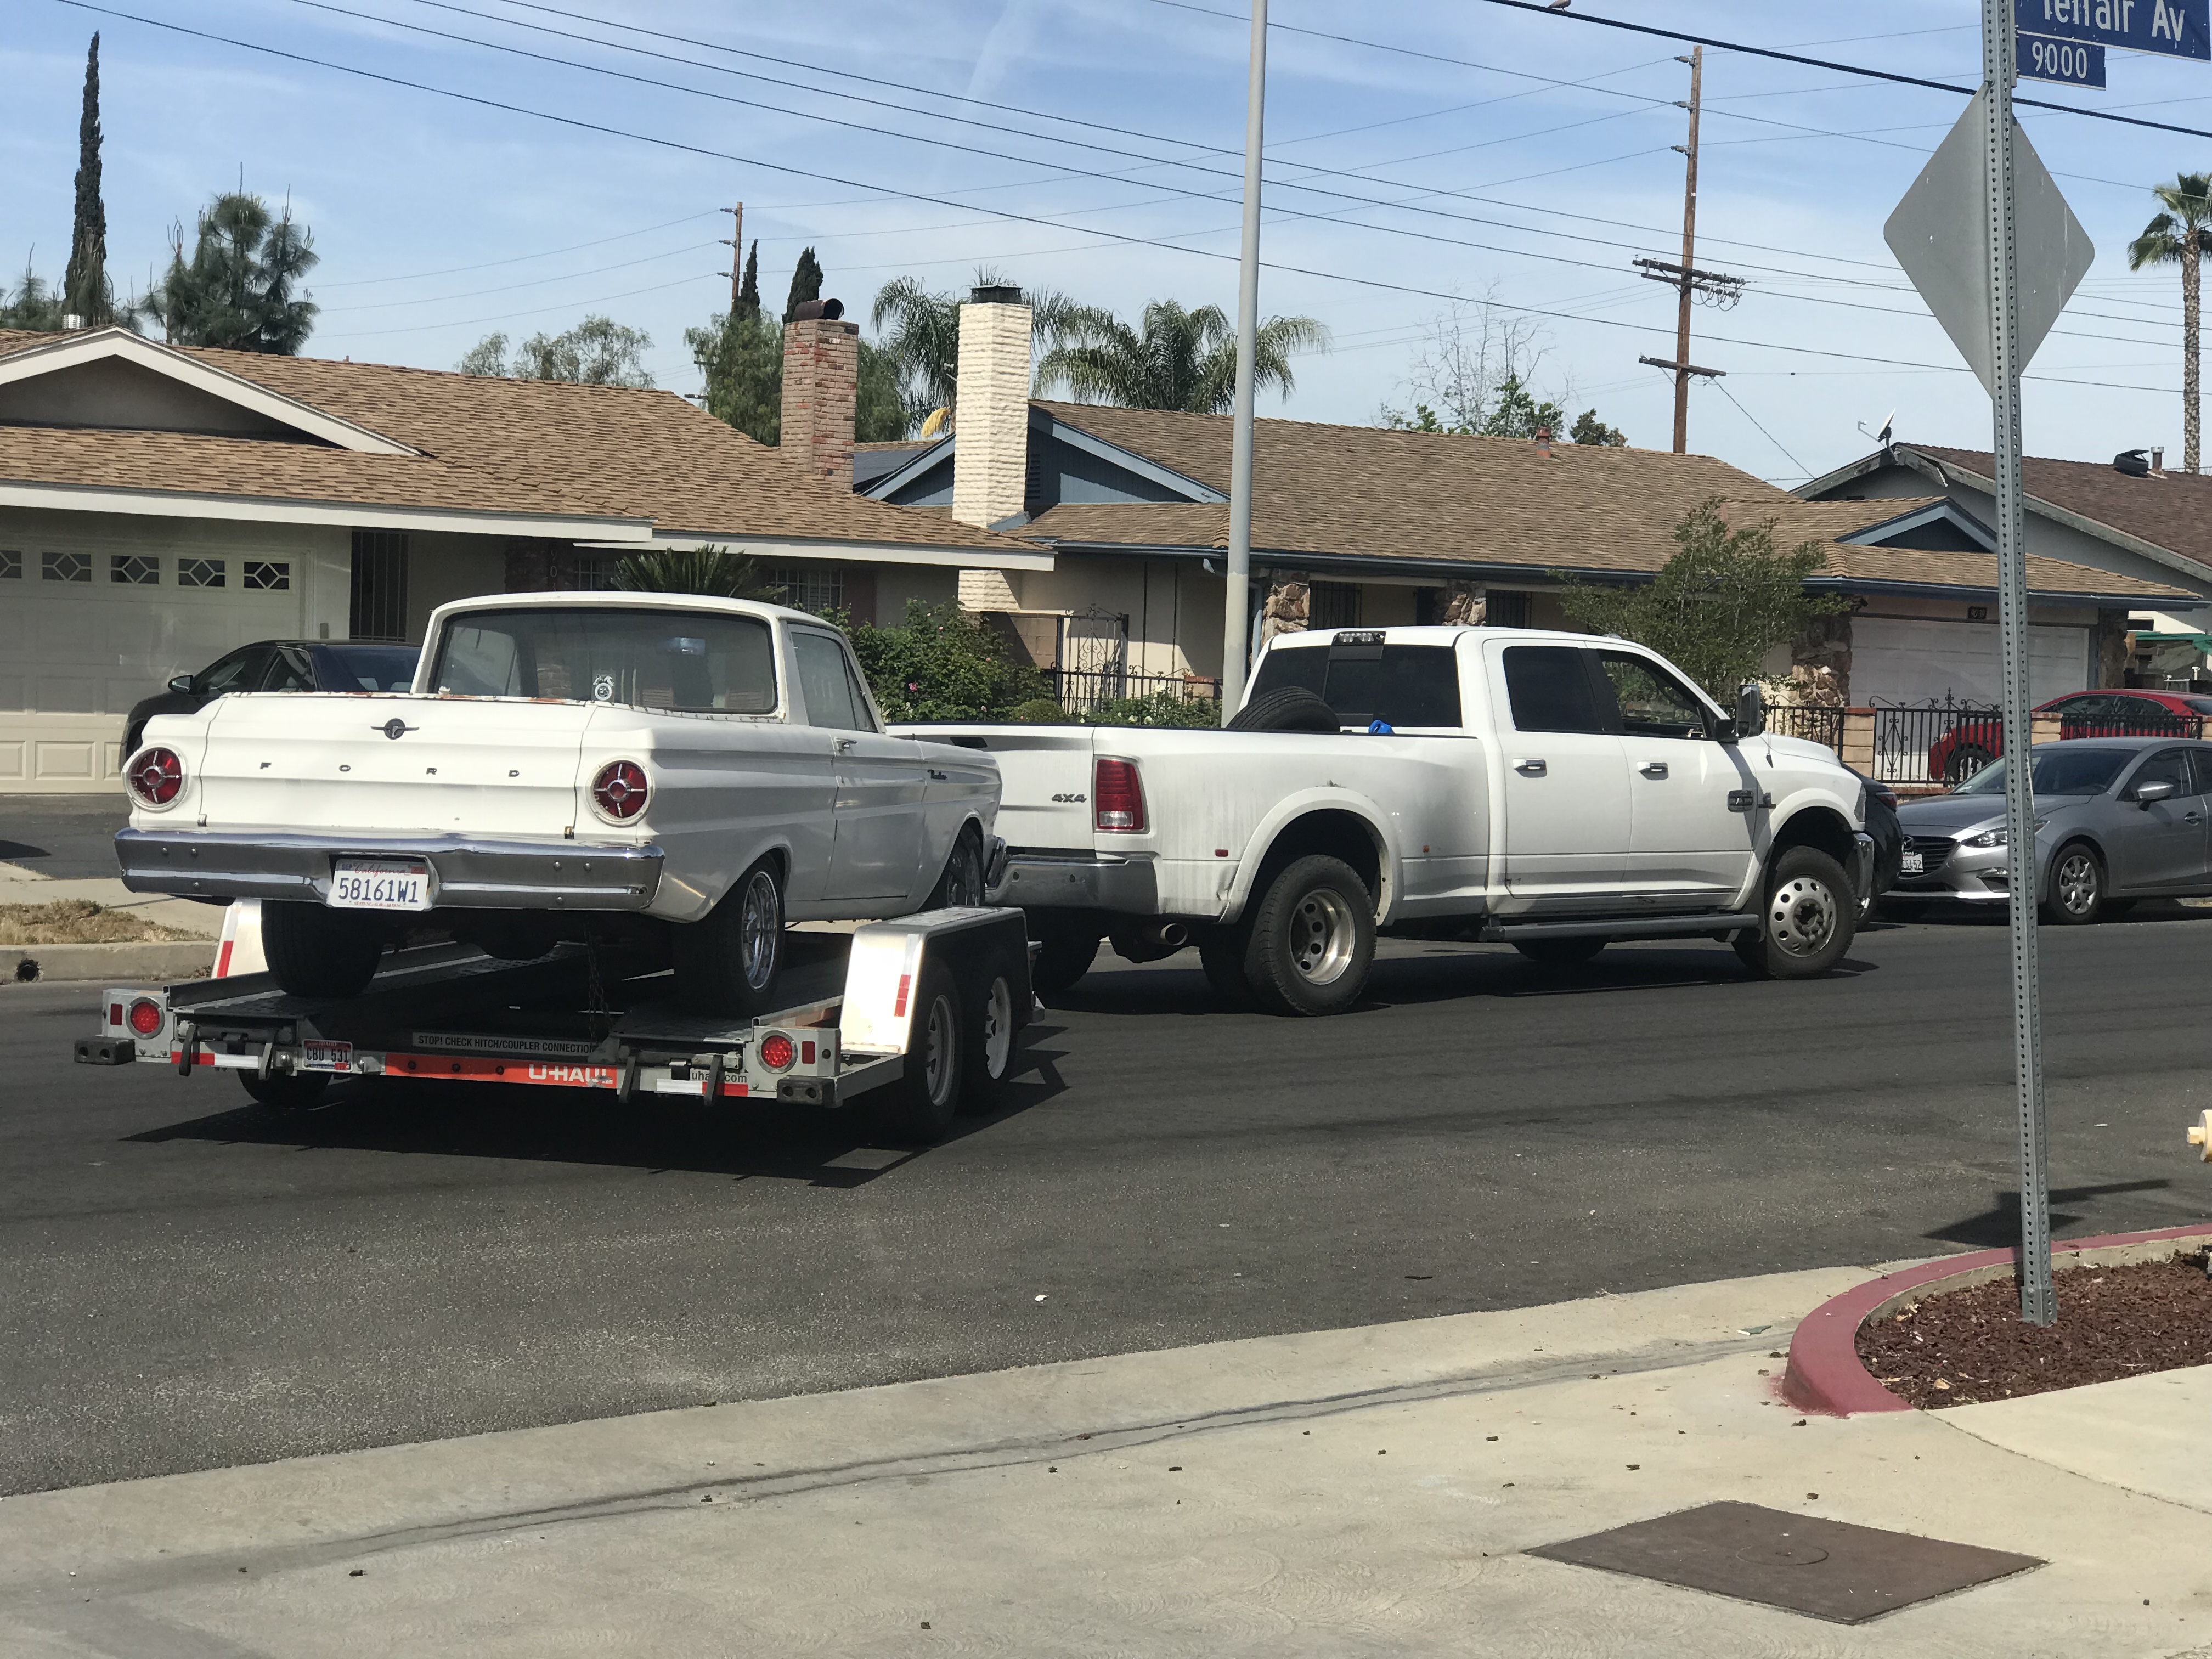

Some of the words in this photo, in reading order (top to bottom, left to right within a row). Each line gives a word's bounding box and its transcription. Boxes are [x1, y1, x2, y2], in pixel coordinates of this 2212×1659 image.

[2152, 0, 2185, 41] Av
[2032, 41, 2087, 79] 9000
[260, 761, 520, 777] FORD
[354, 863, 411, 878] California
[1903, 859, 1921, 870] S452
[338, 877, 419, 903] 58161W1
[419, 1035, 442, 1045] STOP!
[445, 1037, 472, 1047] CHECK
[475, 1039, 540, 1051] HITCH/COUPLER
[331, 1049, 349, 1063] 531
[529, 1064, 613, 1084] U-HAUL
